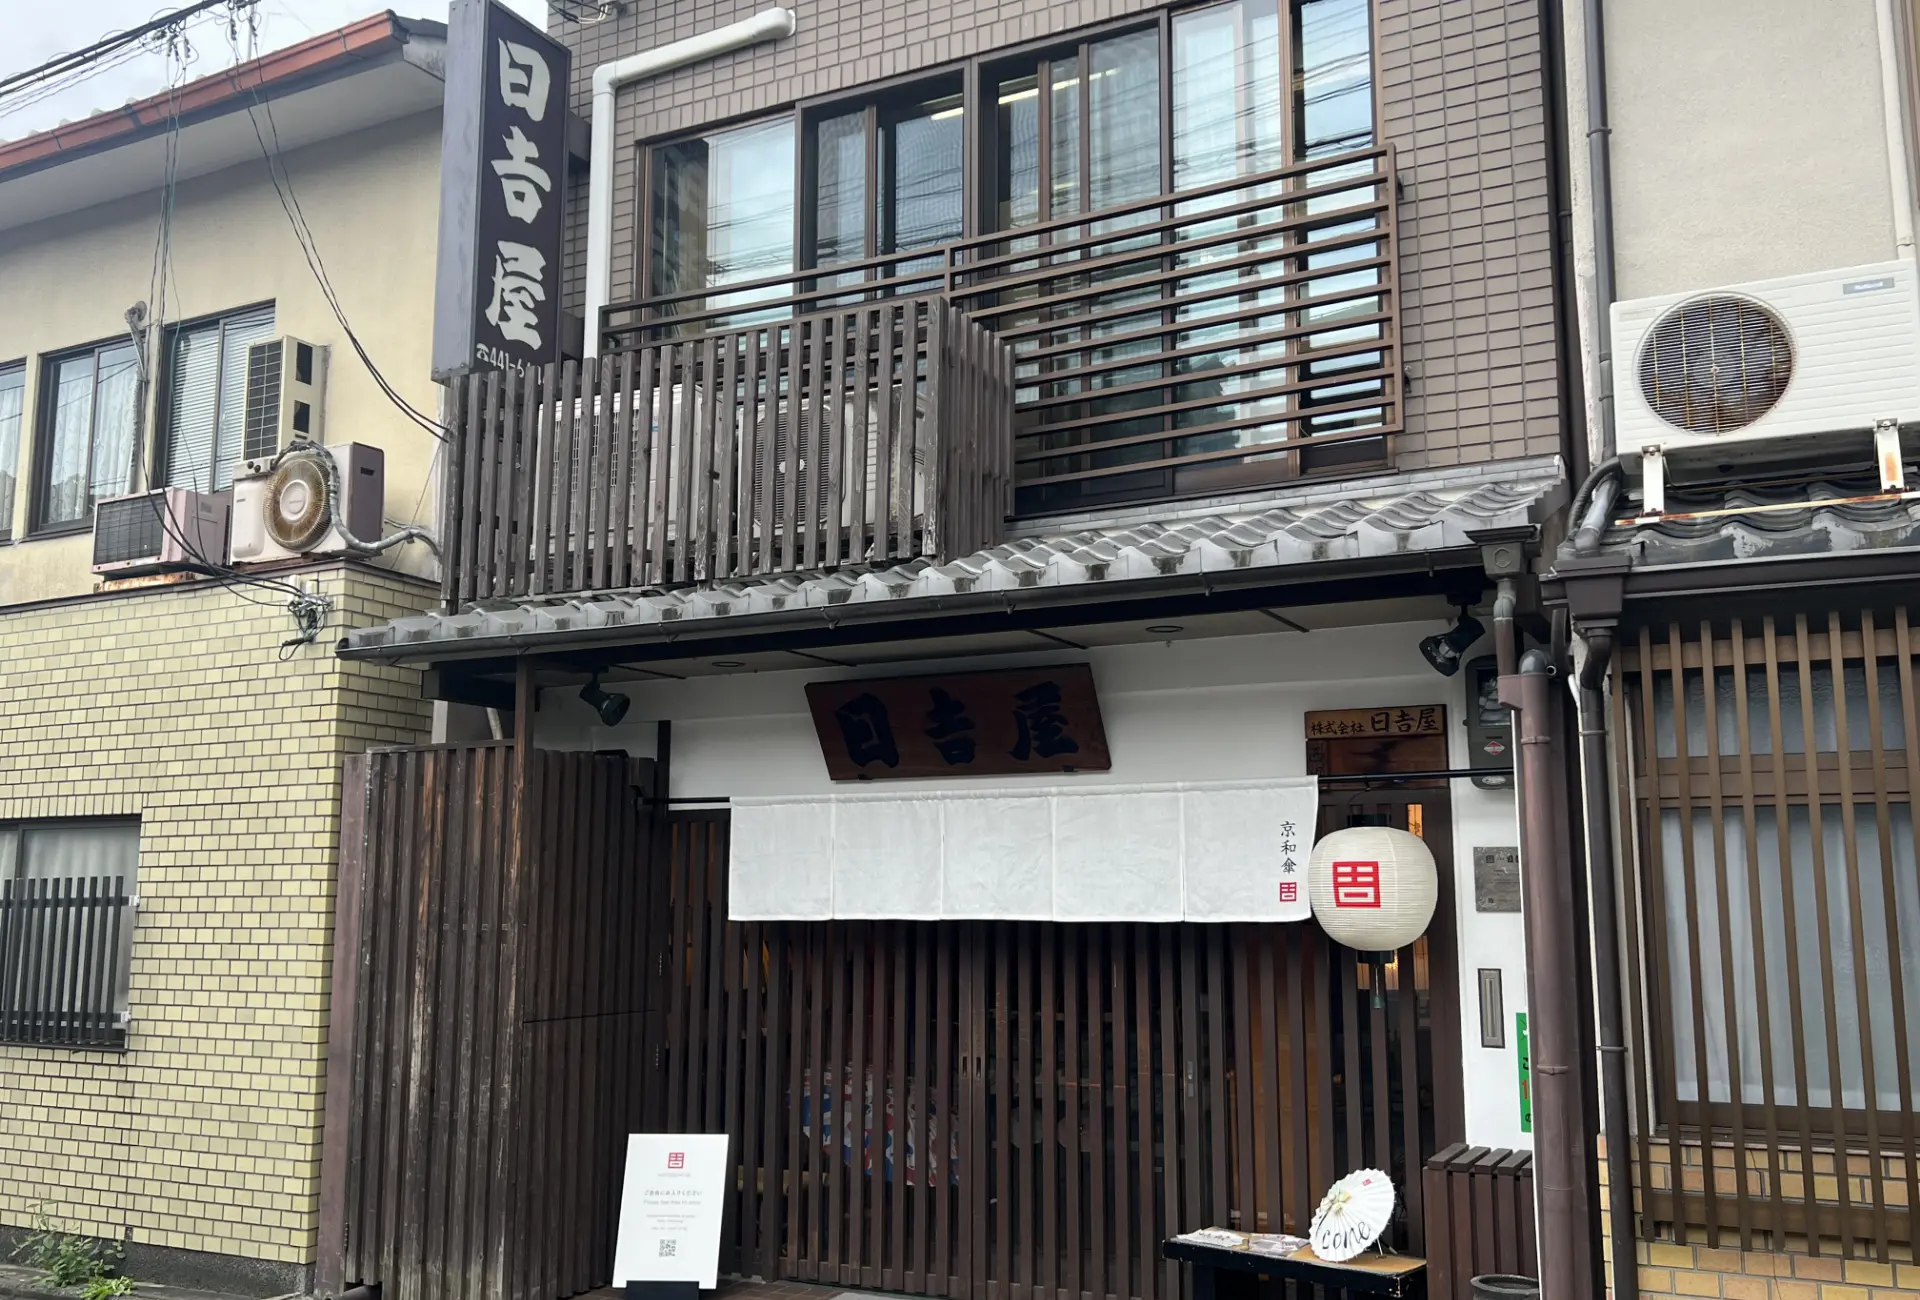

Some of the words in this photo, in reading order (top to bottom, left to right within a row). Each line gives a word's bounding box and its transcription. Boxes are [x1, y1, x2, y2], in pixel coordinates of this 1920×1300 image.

[485, 37, 551, 351] 日吉屋
[835, 681, 1080, 769] 日吉屋
[1280, 820, 1297, 875] 京和傘
